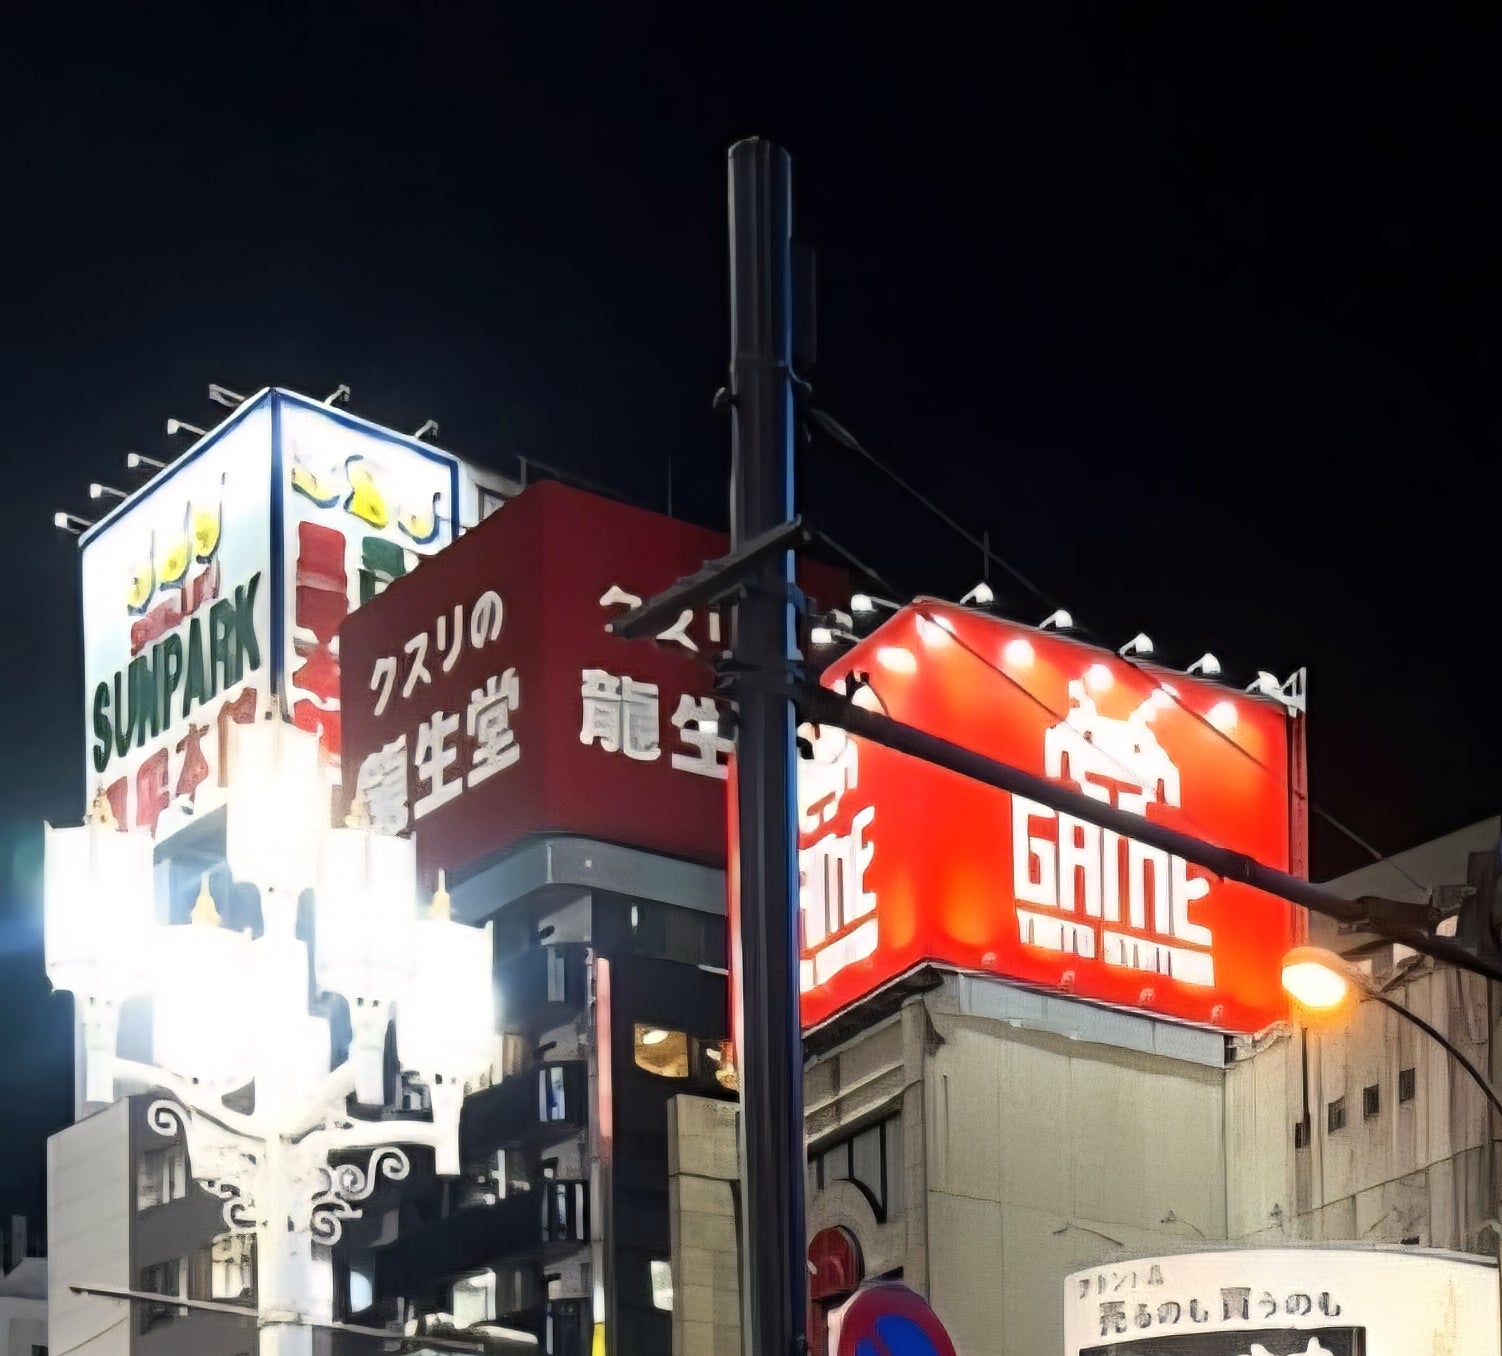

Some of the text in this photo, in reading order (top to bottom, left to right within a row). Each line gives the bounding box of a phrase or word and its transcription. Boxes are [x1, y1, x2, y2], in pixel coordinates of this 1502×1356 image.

[92, 570, 262, 773] SUNPARK
[370, 590, 504, 717] クスリの
